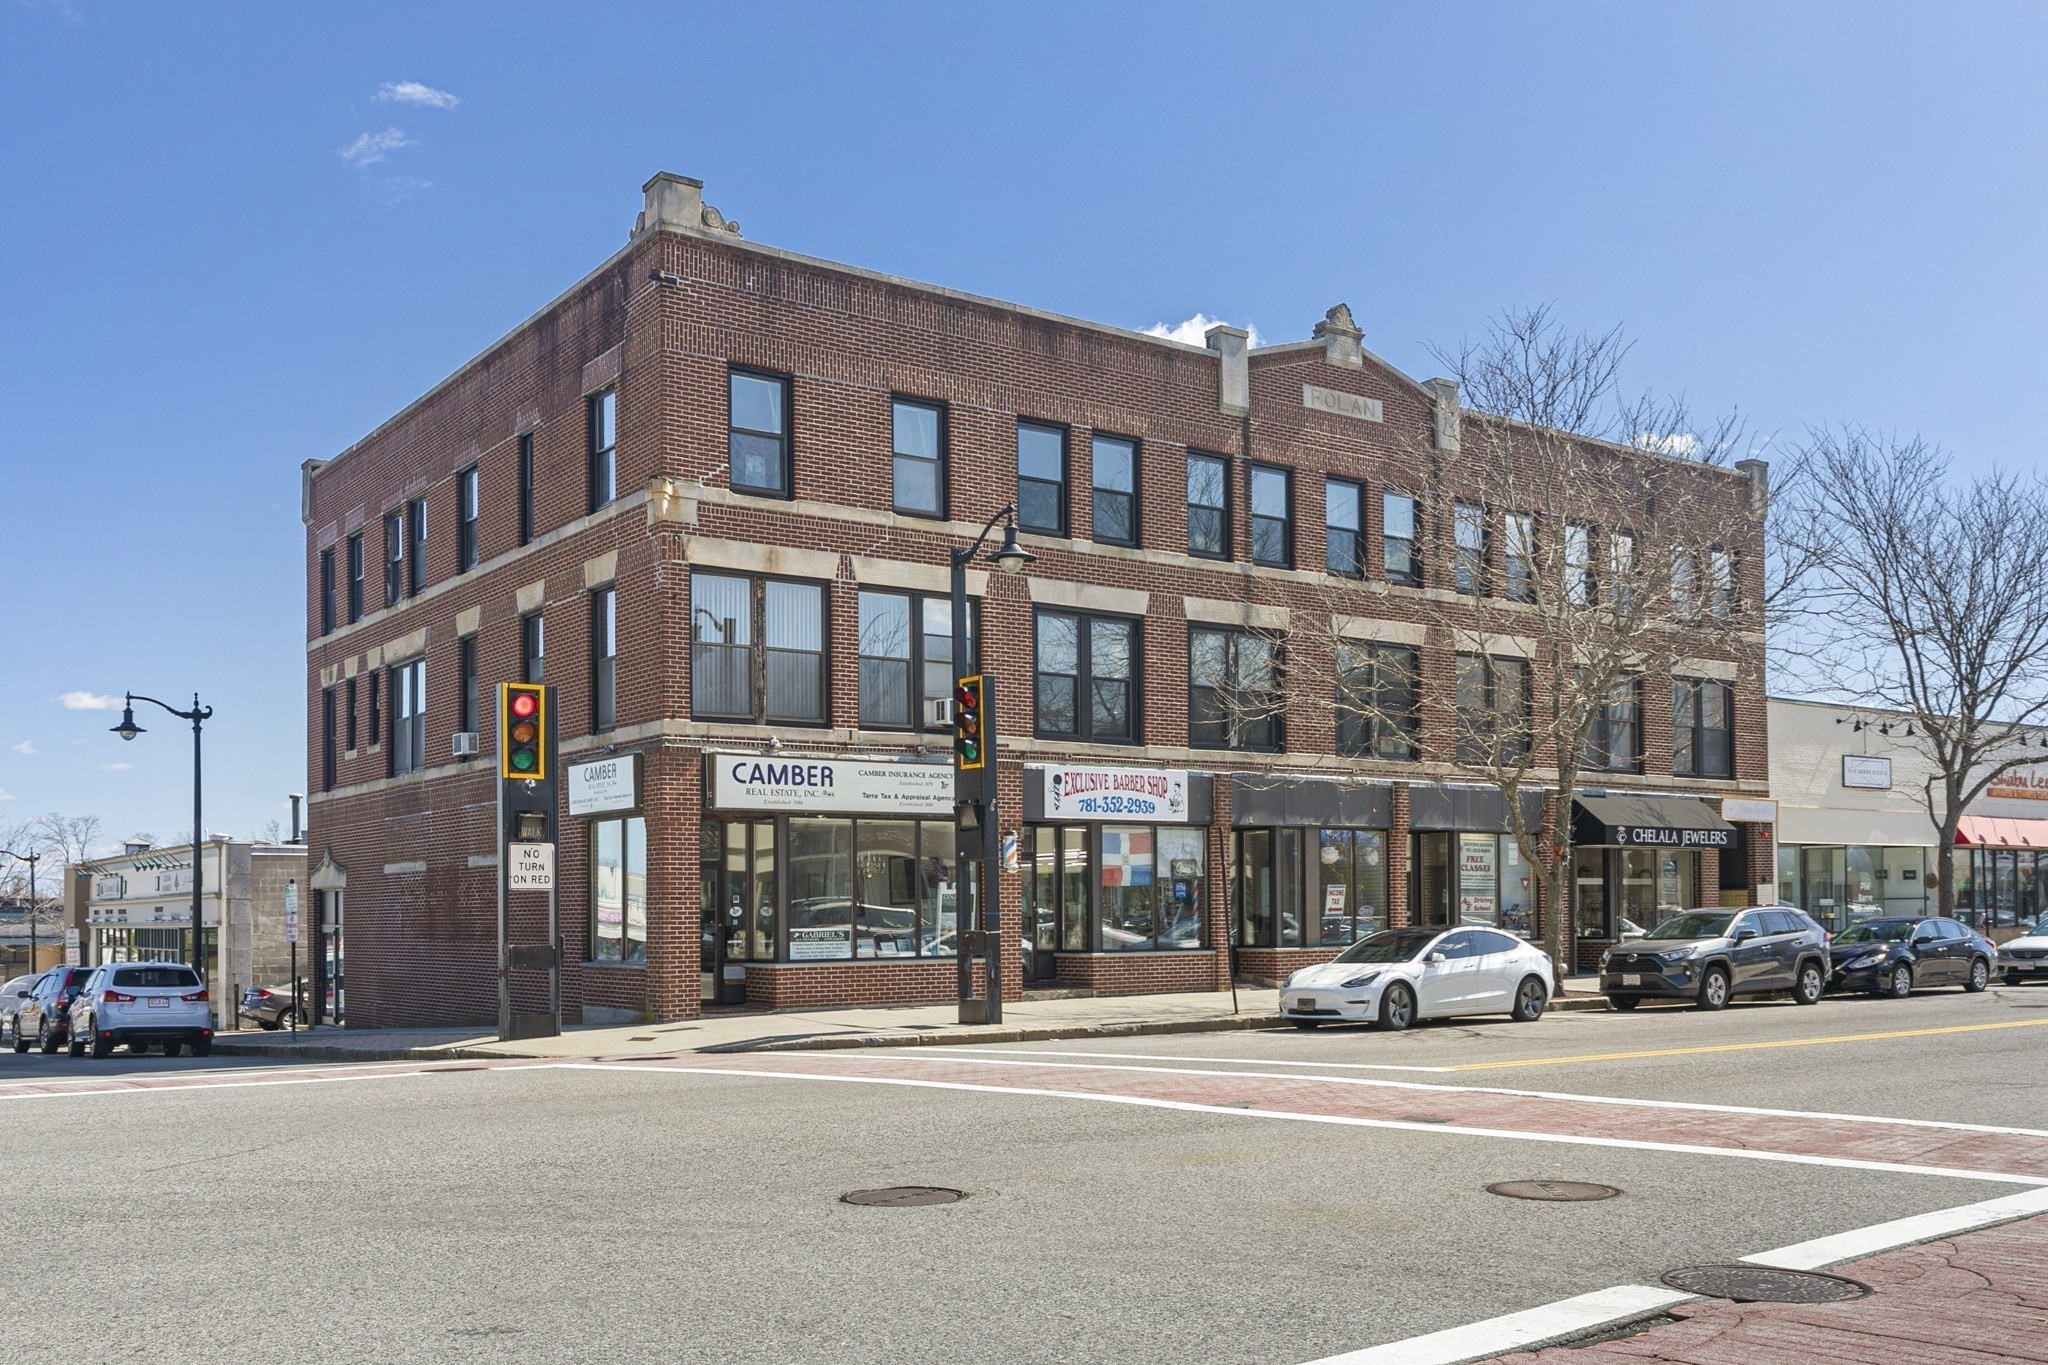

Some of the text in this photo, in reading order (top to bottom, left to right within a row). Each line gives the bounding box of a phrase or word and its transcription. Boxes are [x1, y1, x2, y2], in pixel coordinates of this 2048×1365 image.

[583, 763, 617, 782] CAMBER
[732, 762, 834, 787] CAMBER
[858, 769, 887, 777] CAMBER
[888, 771, 926, 779] INSURANCE
[1063, 772, 1168, 799] EXCLUSIVE BARBER SHOP
[745, 788, 768, 796] REAL
[770, 789, 802, 798] ESTATE,
[901, 794, 931, 802] Appraisal
[1079, 796, 1156, 814] 781-352-2939
[1632, 828, 1728, 847] CHELALA JEWELERS
[523, 849, 540, 859] NO
[519, 862, 545, 872] TURN
[513, 875, 551, 884] ON RED
